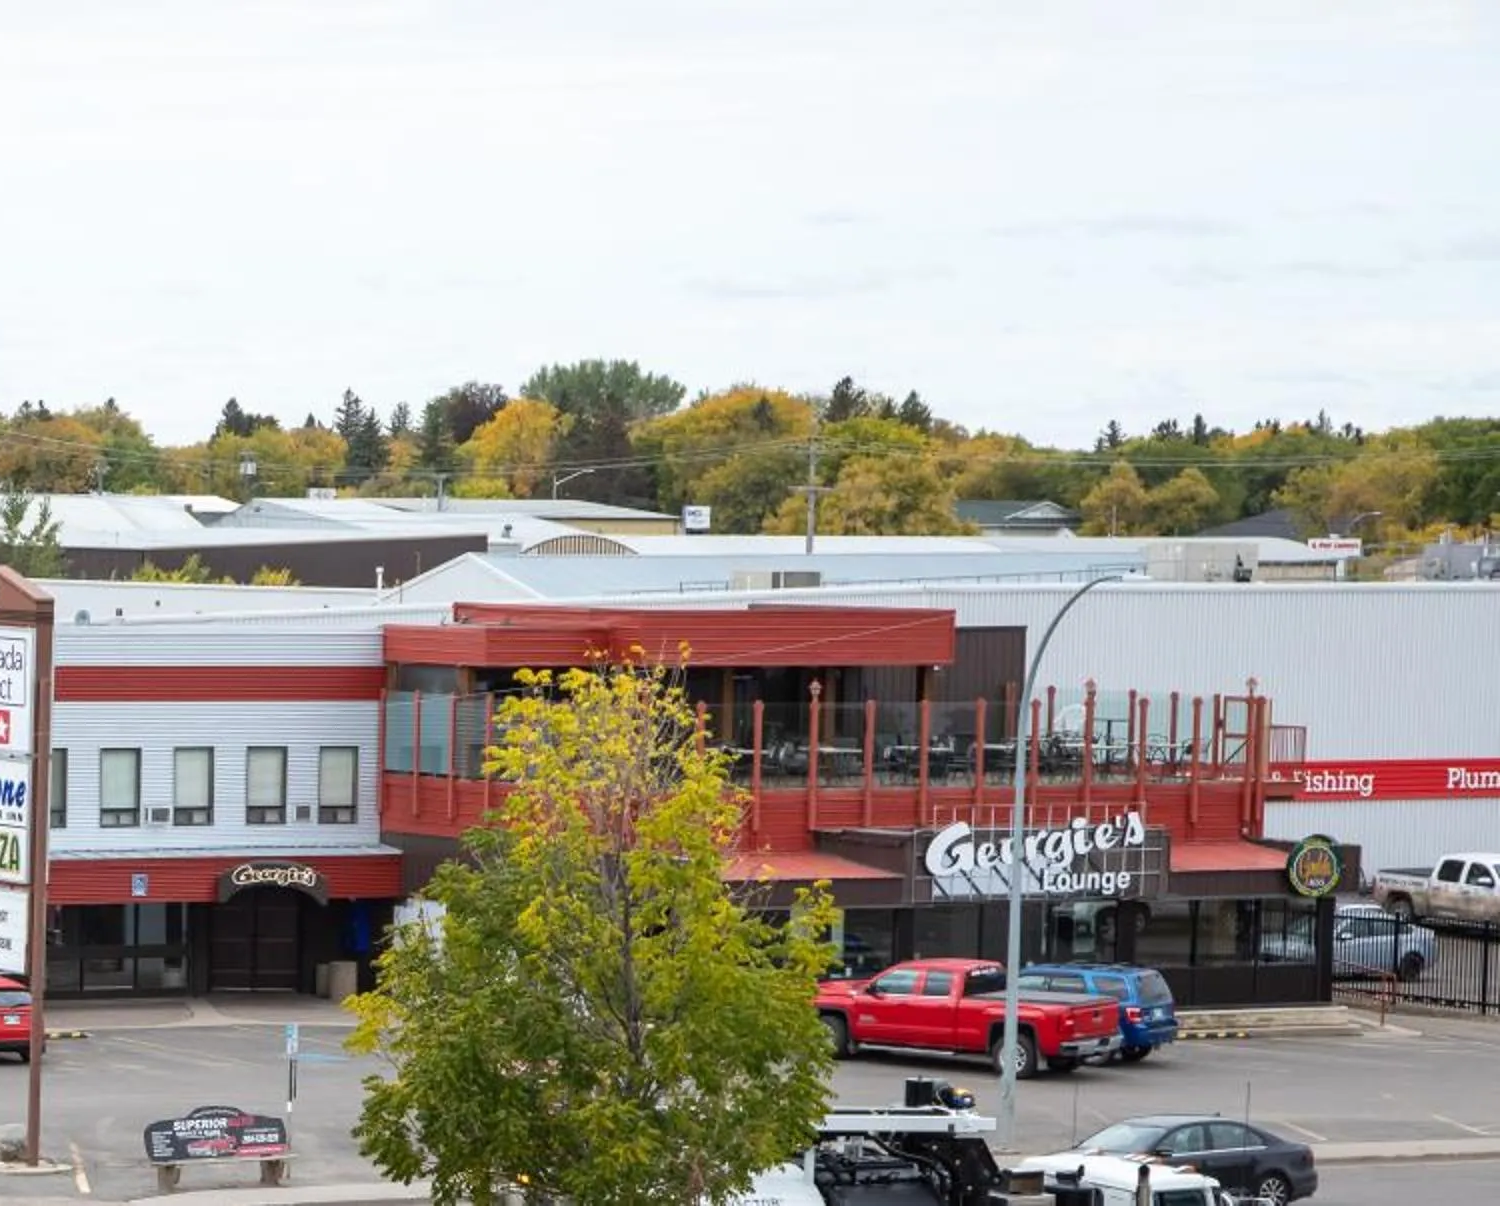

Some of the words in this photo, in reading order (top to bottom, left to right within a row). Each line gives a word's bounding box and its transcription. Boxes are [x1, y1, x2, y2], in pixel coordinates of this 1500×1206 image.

[1446, 767, 1500, 789] Plum
[6, 811, 23, 822] INN
[925, 811, 1145, 876] Georgie's
[231, 864, 316, 887] Georgie's
[1042, 869, 1131, 895] Lounge
[173, 1117, 228, 1131] SUPERIOR
